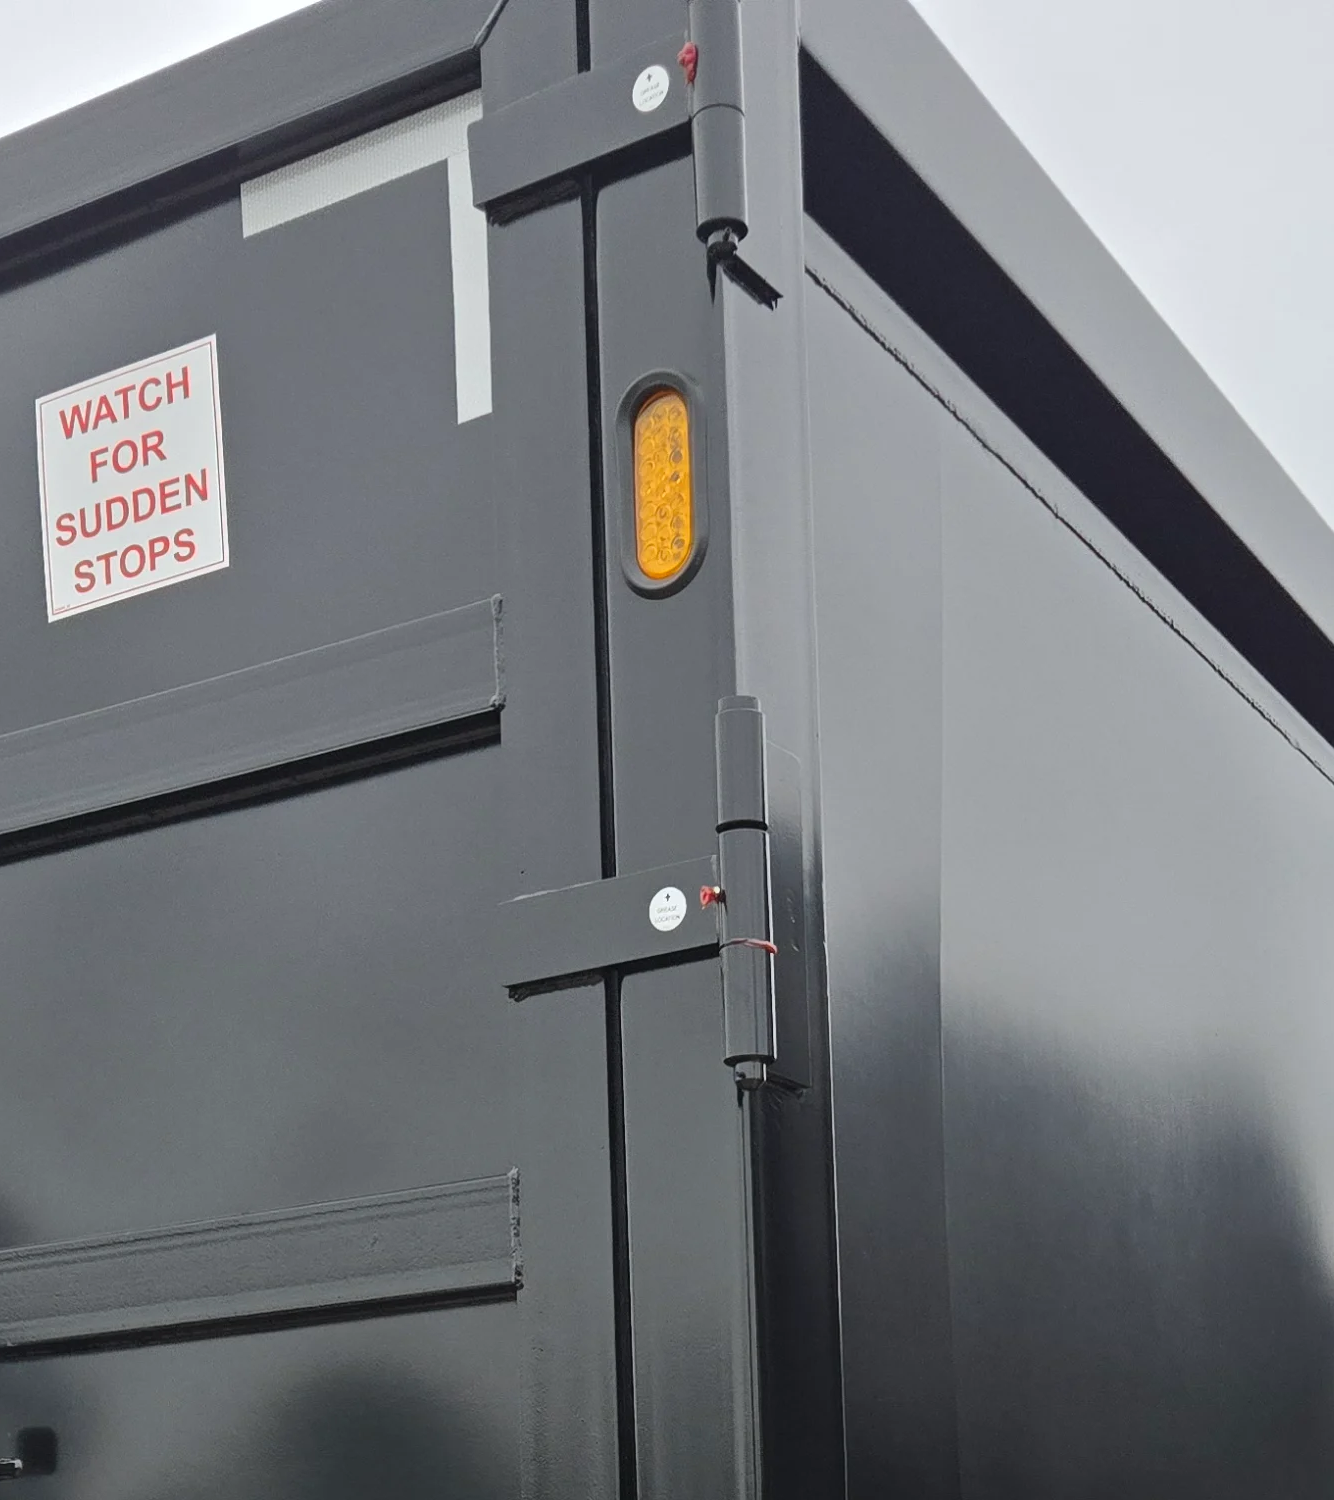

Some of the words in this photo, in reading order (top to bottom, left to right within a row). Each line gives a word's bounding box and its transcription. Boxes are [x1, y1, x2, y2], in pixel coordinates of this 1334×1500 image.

[59, 366, 190, 439] WATCH
[90, 430, 167, 483] FOR
[56, 468, 208, 546] SUDDEN
[74, 528, 196, 593] STOPS
